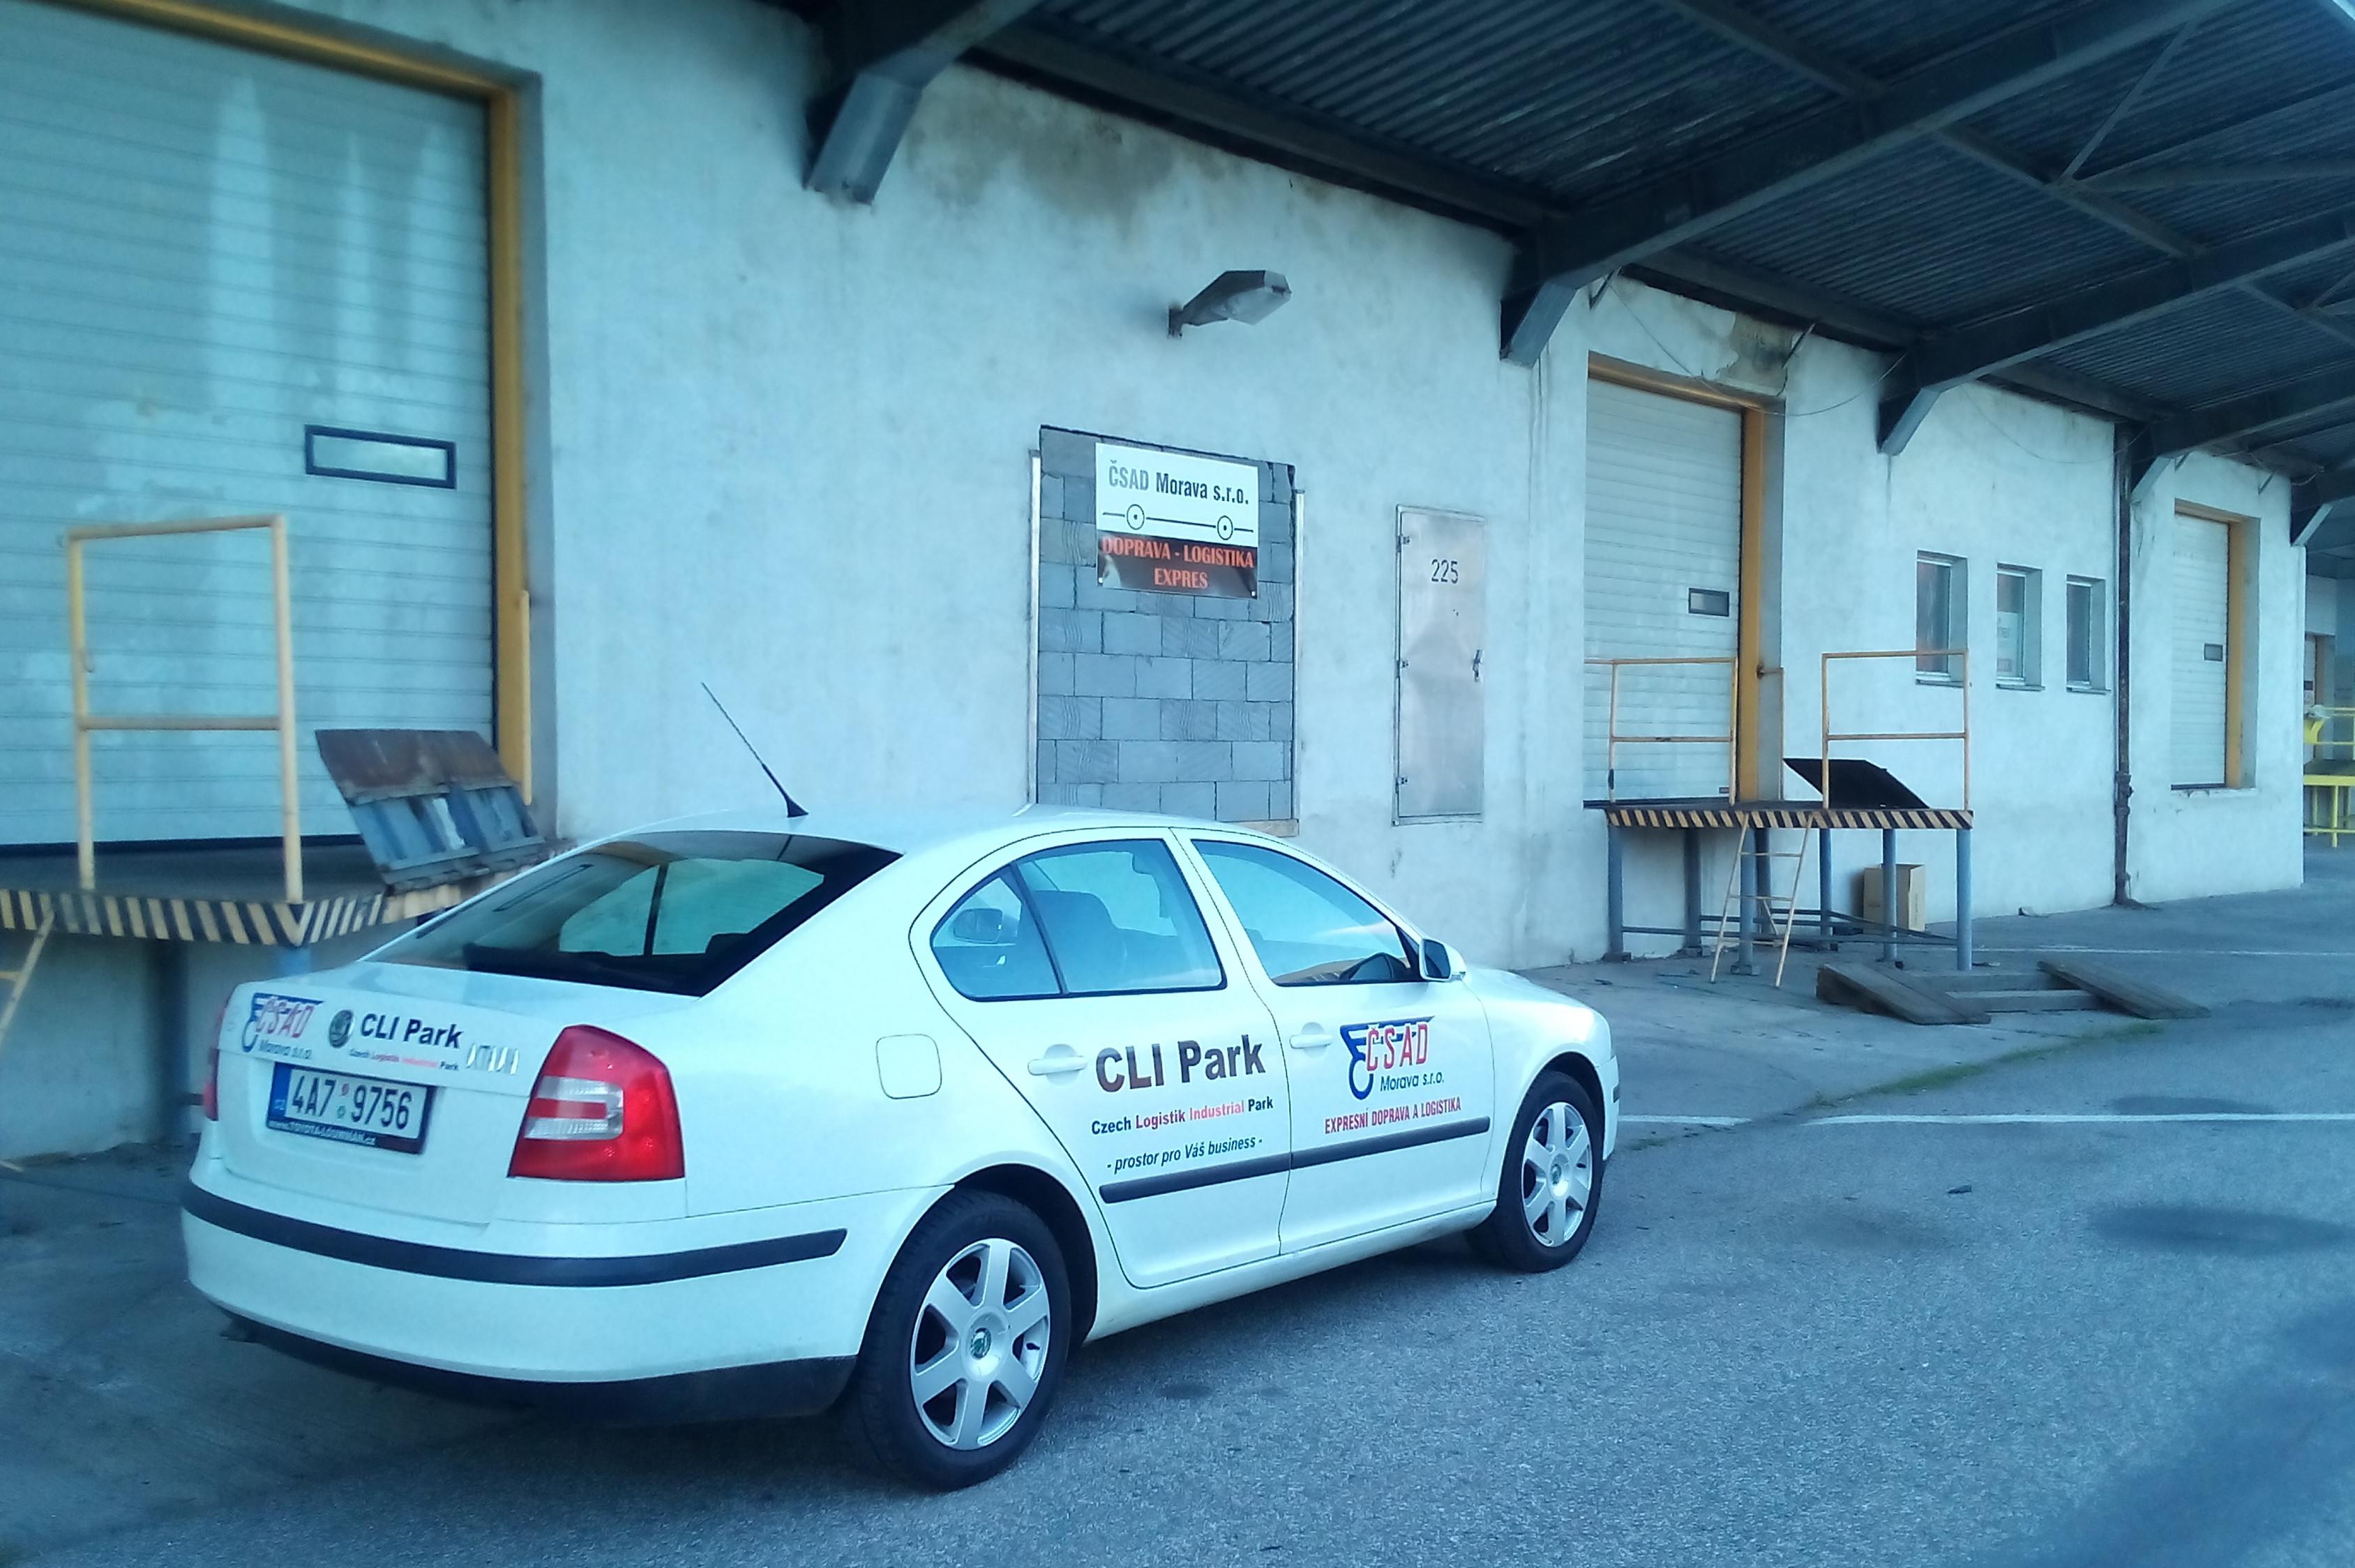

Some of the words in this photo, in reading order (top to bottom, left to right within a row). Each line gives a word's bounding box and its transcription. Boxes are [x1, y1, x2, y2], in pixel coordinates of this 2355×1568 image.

[1108, 460, 1150, 491] ČSAD
[1156, 472, 1207, 499] Morava
[1213, 485, 1249, 504] s.r.o.
[1102, 536, 1171, 559] DOPRAVA
[1184, 545, 1254, 568] LOGISTIKA
[1154, 568, 1208, 589] EXPRES
[1431, 559, 1459, 585] 225
[360, 1013, 400, 1040] CLI
[403, 1018, 464, 1049] Park
[1095, 1043, 1164, 1092] CLI
[1178, 1034, 1266, 1083] Park
[1380, 1074, 1419, 1092] Morava
[1422, 1071, 1445, 1086] s.r.o.
[292, 1075, 337, 1117] 4A7
[351, 1084, 412, 1130] 9756
[1092, 1117, 1131, 1135] Czech
[1136, 1109, 1186, 1130] Logistik
[1189, 1100, 1244, 1121] Industrial
[1248, 1096, 1274, 1112] Park
[1325, 1108, 1369, 1134] EXPRESNÍ
[1371, 1106, 1410, 1126] DOPRAVA
[1413, 1104, 1419, 1119] A
[1421, 1096, 1461, 1117] LOGISTIKA
[1114, 1152, 1159, 1174] prostor
[1161, 1149, 1181, 1166] pro
[1185, 1140, 1205, 1159] Váš
[1208, 1136, 1256, 1156] business
